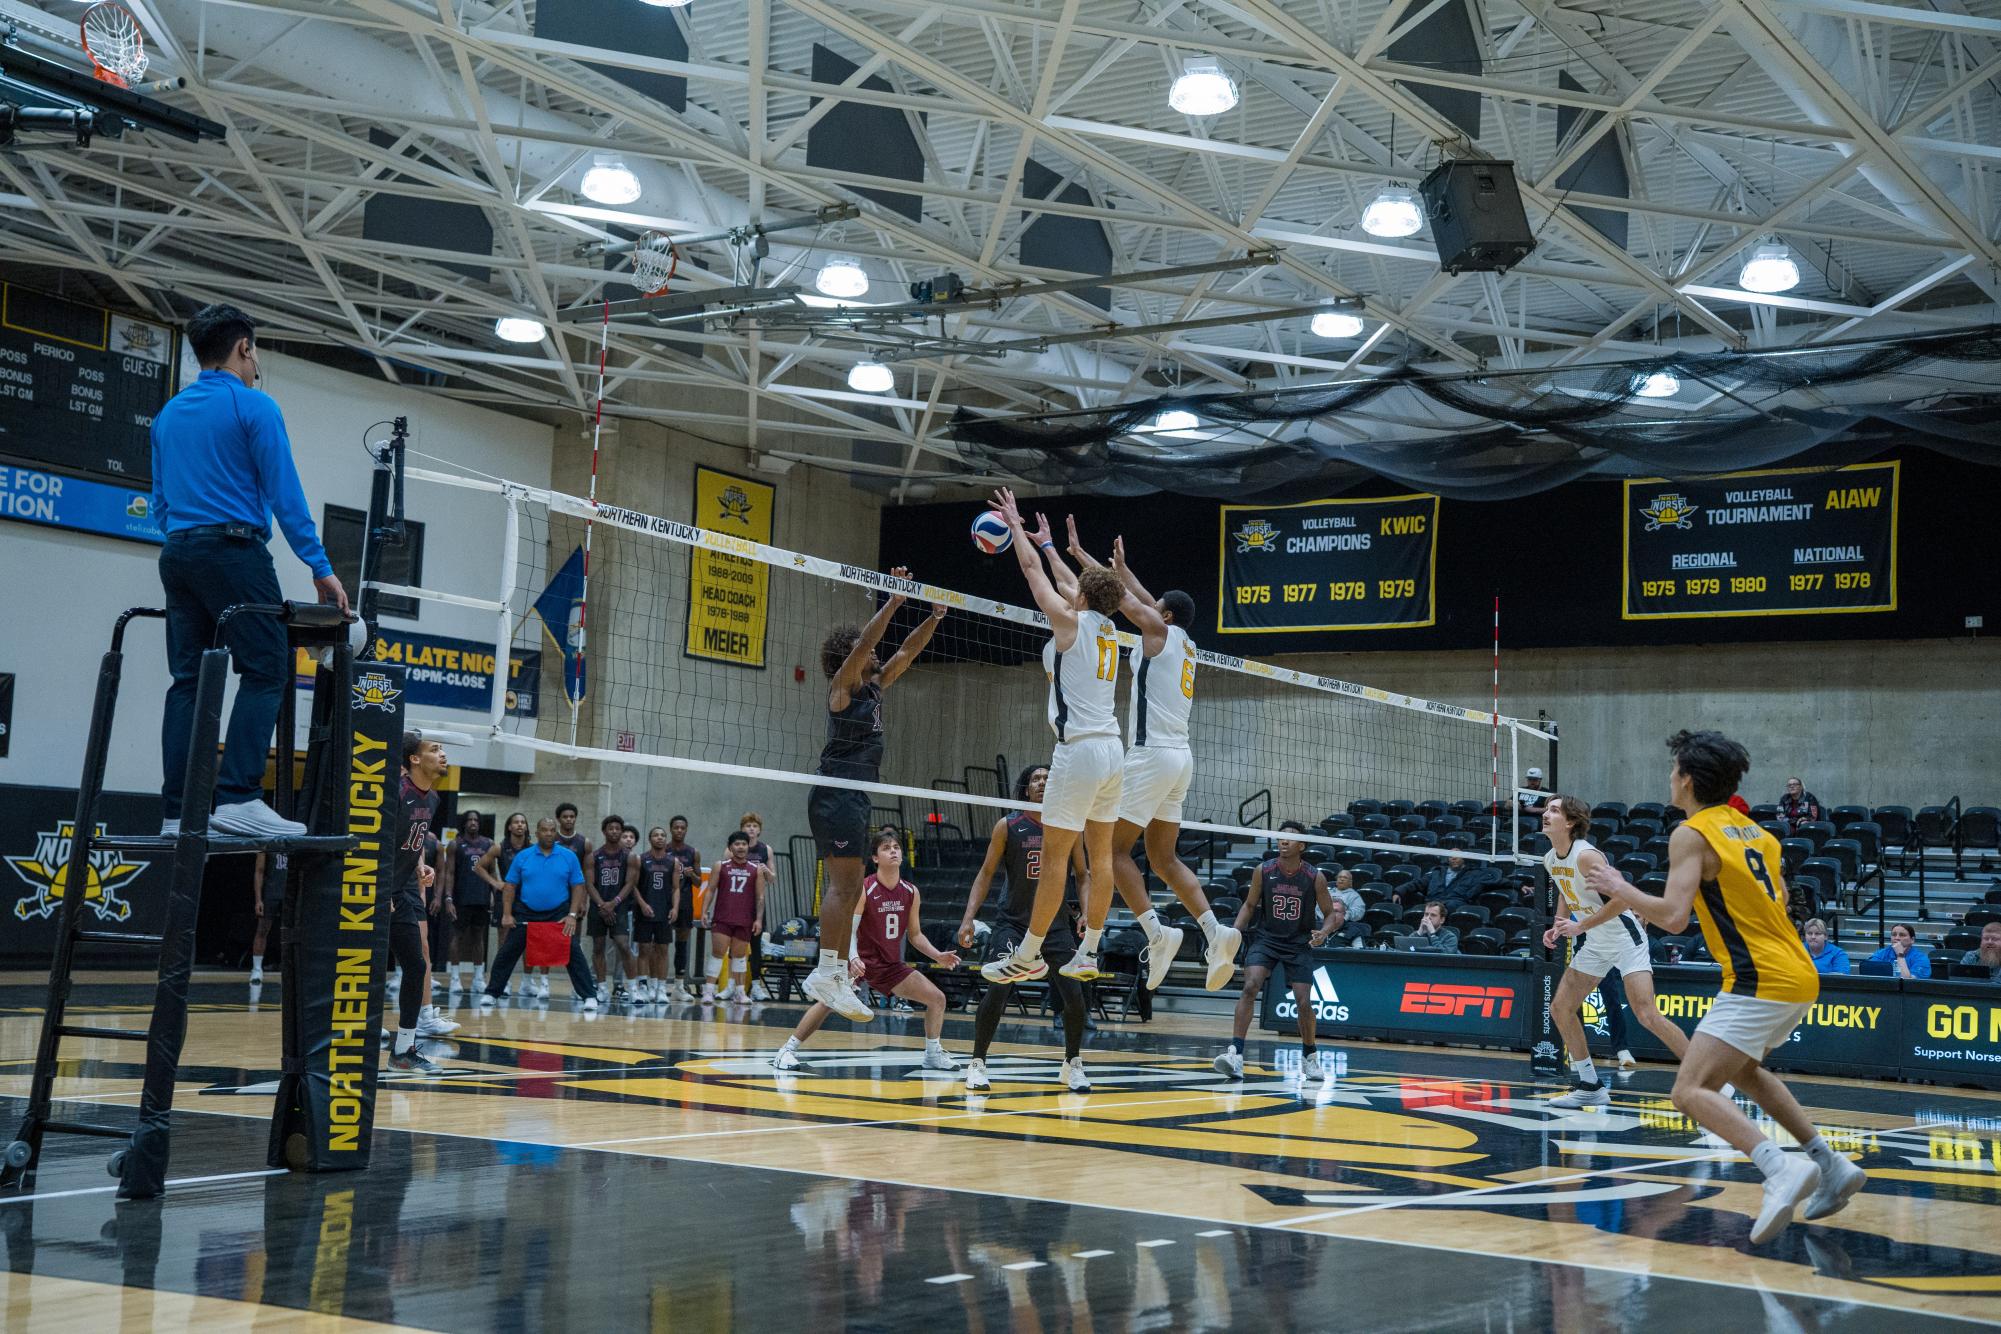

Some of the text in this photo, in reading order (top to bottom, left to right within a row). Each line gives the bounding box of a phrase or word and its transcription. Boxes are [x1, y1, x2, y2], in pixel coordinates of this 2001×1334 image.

[0, 348, 28, 365] POSS
[34, 342, 75, 362] PERIOD
[0, 367, 33, 385] BONUS
[78, 367, 105, 384] POSS
[122, 356, 161, 380] GUEST
[18, 388, 34, 401] GM
[71, 384, 103, 401] BONUS
[69, 400, 104, 416] LST GM
[135, 413, 152, 427] WO
[107, 459, 124, 473] TOL
[15, 470, 63, 497] FOR
[0, 491, 60, 521] TION.
[1652, 500, 1685, 510] NORSE
[1725, 487, 1881, 510] VOLLEYBALL AIAW
[596, 505, 648, 530] NORTHERN
[650, 517, 701, 542] KENTUCKY
[1706, 504, 1814, 525] TOURNAMENT
[1302, 515, 1426, 536] VOLLEYBALL KWIC
[1286, 533, 1371, 553] CHAMPIONS
[1672, 552, 1737, 568] REGIONAL
[1793, 546, 1864, 562] NATIONAL
[708, 565, 754, 585] 1988-2009
[839, 564, 881, 585] NORTHERN
[882, 575, 922, 595] KENTUCKY
[1789, 572, 1871, 591] 1977 1978
[702, 585, 755, 609] HEAD COACH
[1236, 579, 1415, 604] 1975 1977 1978 1979
[1642, 576, 1766, 597] 1975 1979 1980
[704, 627, 750, 657] MEIER
[375, 637, 523, 678] $4 LATE NIGT
[1096, 635, 1117, 682] 17
[360, 678, 391, 690] NORSE
[413, 667, 486, 689] 9PM-CLOSE
[1180, 658, 1194, 700] 6
[1317, 677, 1341, 690] NORTHERN
[400, 821, 428, 852] 16
[601, 867, 620, 886] 20
[653, 871, 664, 890] 5
[729, 875, 748, 893] 17
[1744, 848, 1776, 902] 9
[1273, 895, 1301, 920] 23
[886, 913, 899, 939] 8
[1543, 975, 1552, 1002] sports
[1275, 1000, 1349, 1021] addas
[1400, 982, 1514, 1019] ESPN
[1542, 1001, 1551, 1035] imports
[1654, 994, 1882, 1030] ORTH TUCKY
[1927, 1004, 1978, 1041] GO
[328, 948, 373, 1151] NORTHERN
[1914, 1046, 2001, 1063] Support Norse
